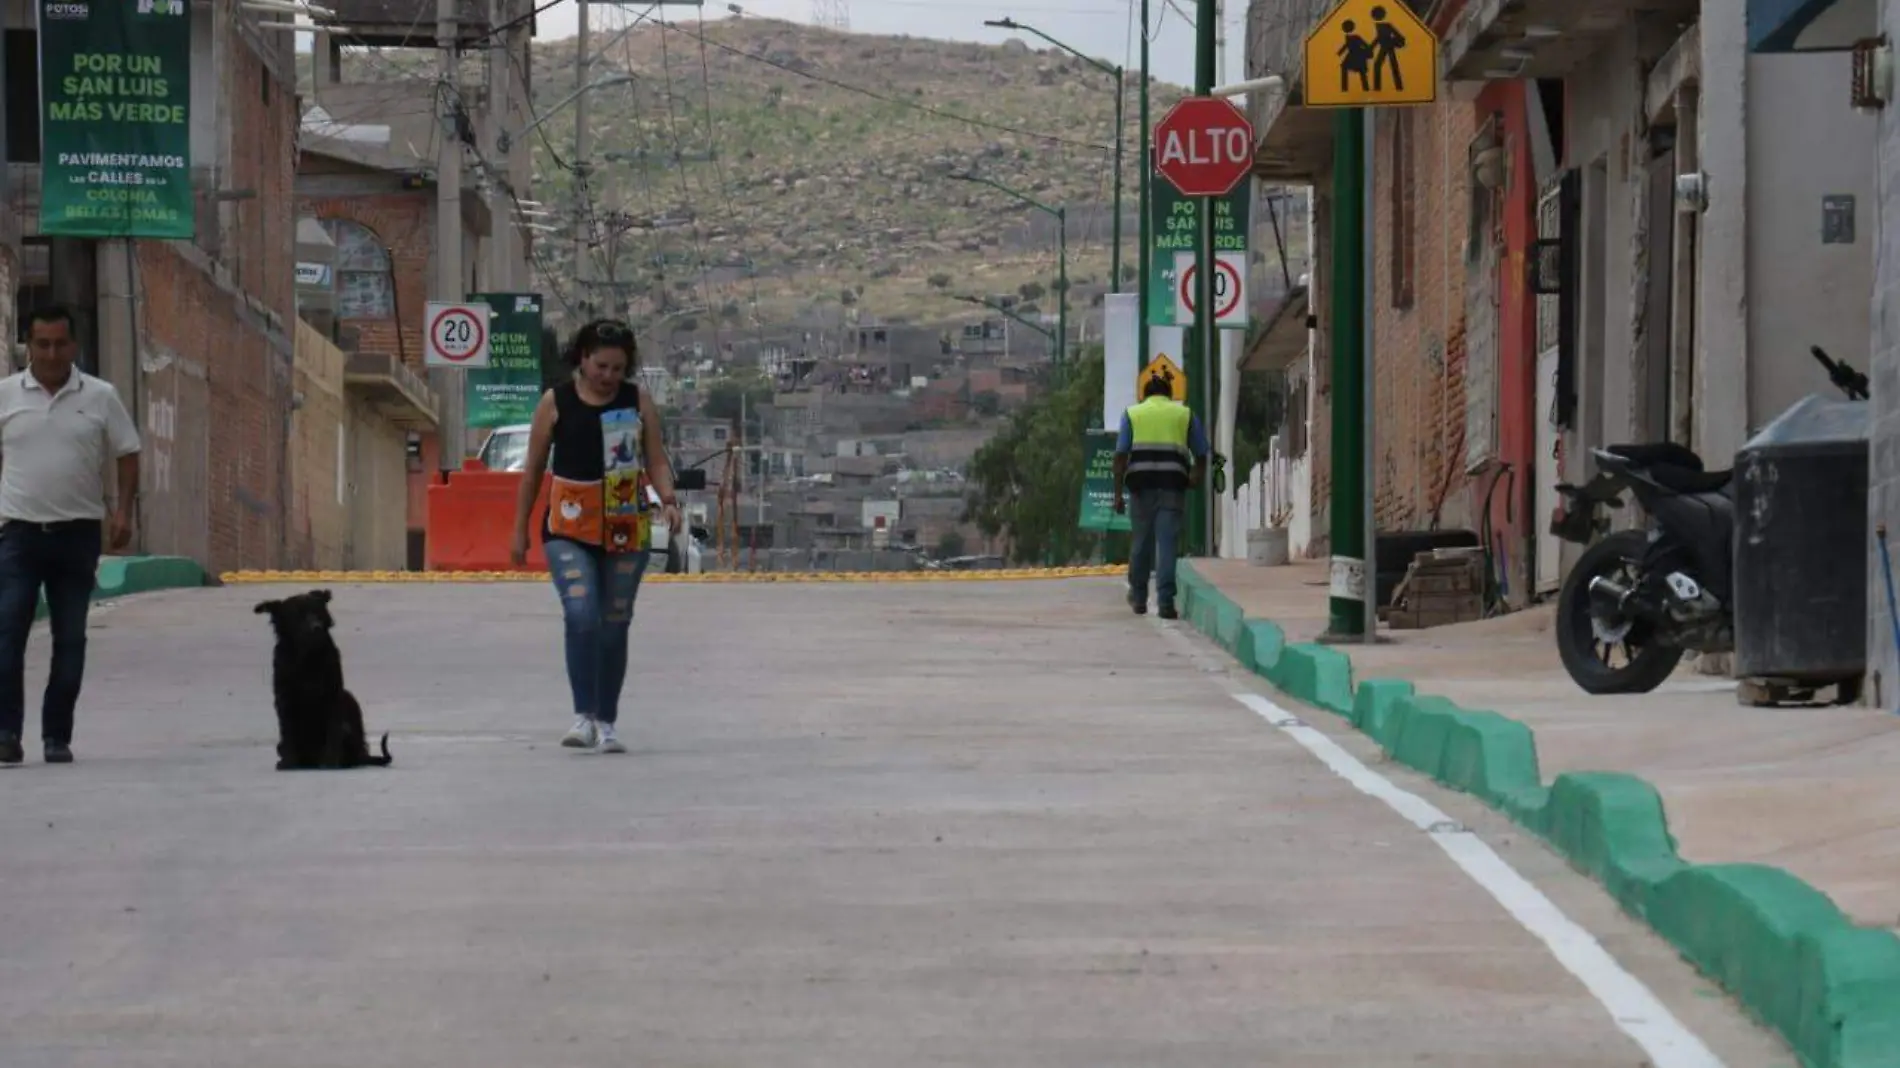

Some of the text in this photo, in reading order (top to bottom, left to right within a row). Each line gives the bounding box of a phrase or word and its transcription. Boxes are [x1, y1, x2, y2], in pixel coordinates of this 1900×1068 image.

[73, 53, 161, 74] POR UN
[63, 76, 168, 97] SAN LUIS
[50, 97, 185, 123] MÁS VERDE
[1161, 126, 1249, 165] ALTO
[58, 152, 184, 168] PAVIMENTAMOS
[88, 171, 143, 184] CALLES
[1172, 201, 1195, 214] PO
[1215, 235, 1245, 248] RDE
[444, 320, 470, 342] 20
[490, 333, 508, 342] OR
